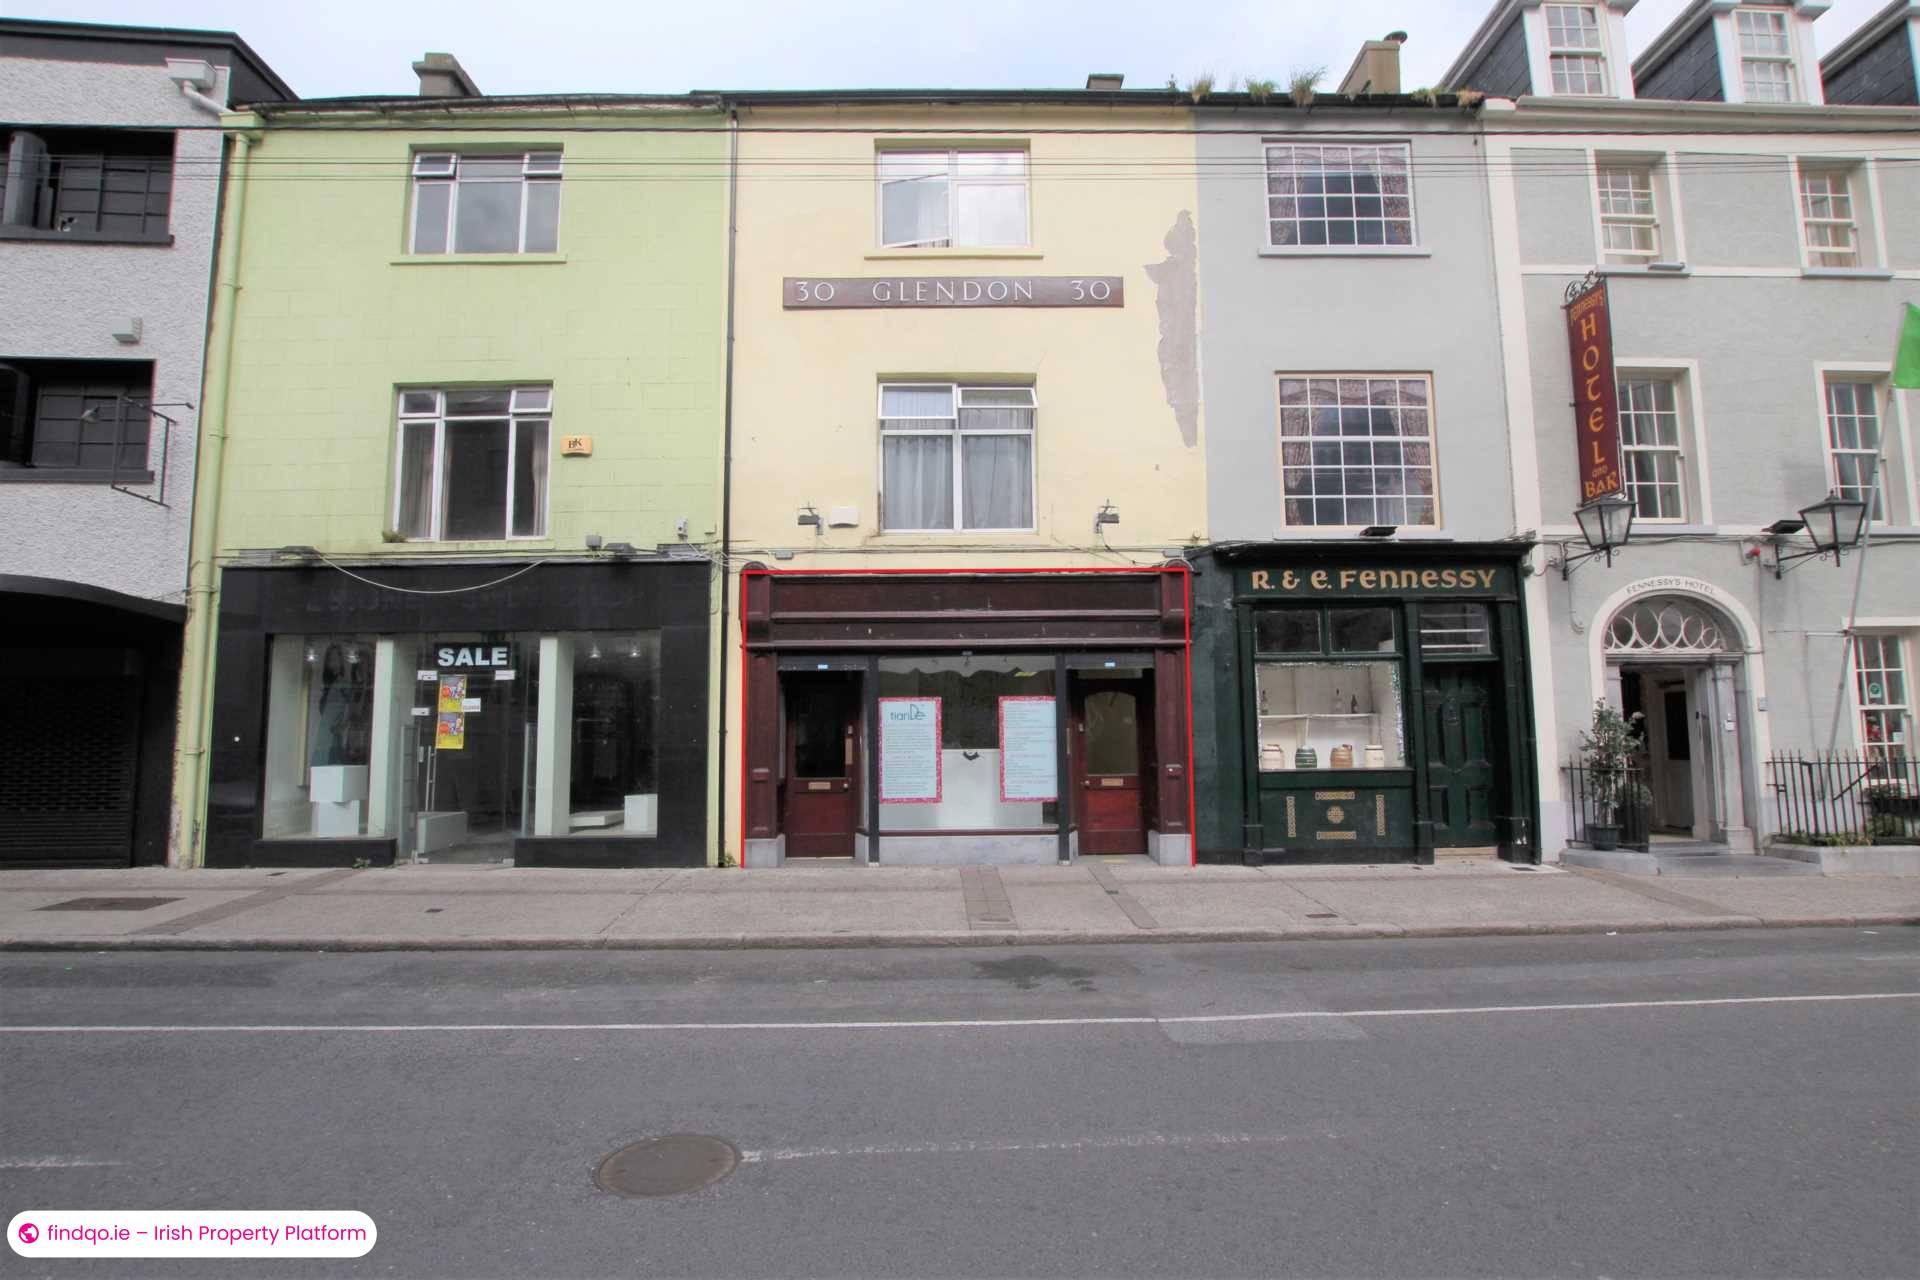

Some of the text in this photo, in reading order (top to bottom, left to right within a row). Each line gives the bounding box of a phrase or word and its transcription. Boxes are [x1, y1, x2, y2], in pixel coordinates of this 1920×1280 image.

[795, 279, 1111, 303] 30 GLENDON 30
[1580, 312, 1606, 465] HOTEL
[1584, 469, 1617, 498] BAR
[1251, 569, 1276, 590] R.
[1281, 570, 1300, 590] &
[1684, 580, 1716, 595] HOTEL
[437, 647, 508, 667] SALE
